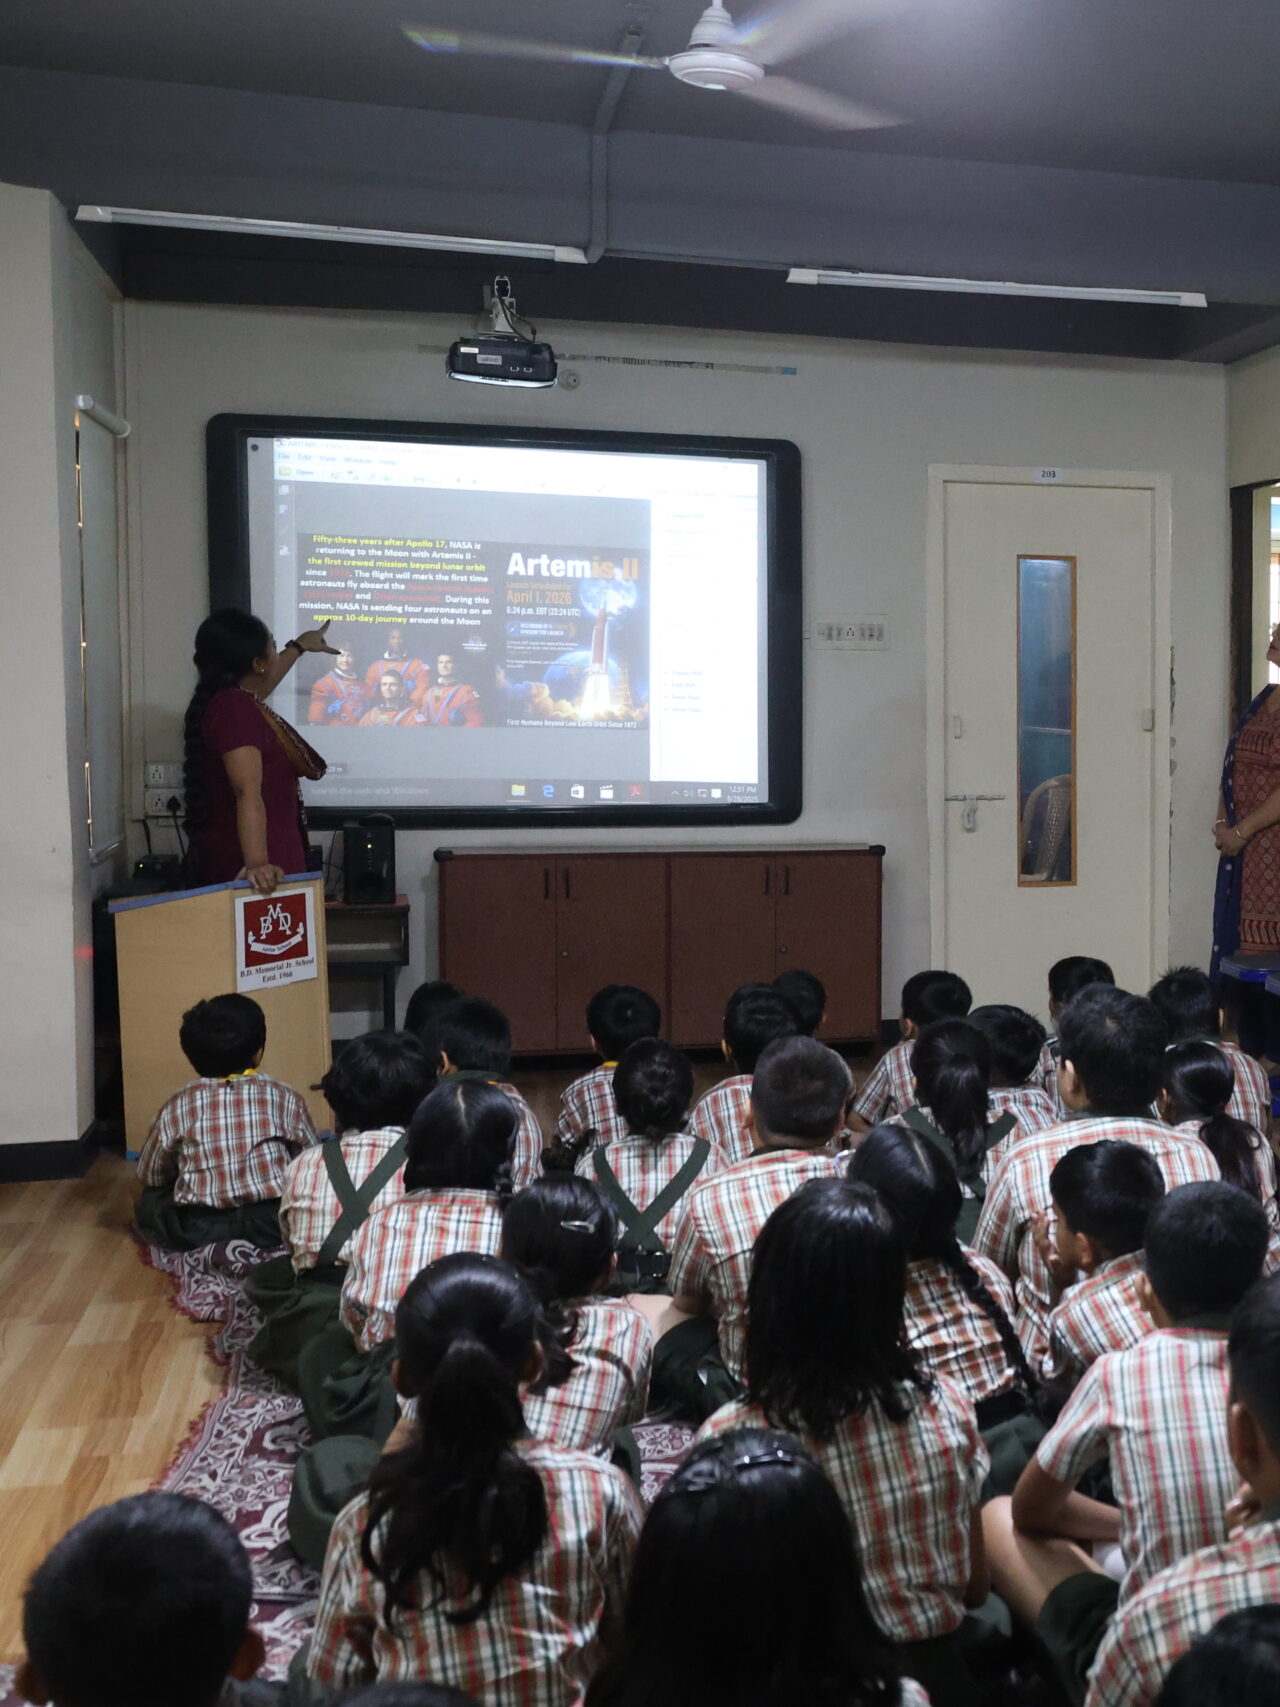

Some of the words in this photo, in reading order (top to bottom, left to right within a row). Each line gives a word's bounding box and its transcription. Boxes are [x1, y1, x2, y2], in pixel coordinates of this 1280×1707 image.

[1041, 470, 1056, 478] 203
[313, 535, 357, 544] Fifty-three
[360, 538, 382, 546] years
[384, 538, 404, 546] after
[406, 539, 433, 548] Apollo
[449, 541, 472, 549] NASA
[316, 547, 355, 557] returning
[368, 547, 382, 556] the
[384, 549, 409, 557] Moon
[411, 550, 429, 558] with
[432, 551, 464, 559] Artemis
[307, 557, 322, 565] the
[324, 557, 341, 565] first
[343, 559, 374, 567] crewed
[376, 560, 408, 568] mission
[410, 561, 440, 570] beyond
[442, 562, 464, 570] lunar
[507, 552, 614, 579] Artemis
[306, 568, 327, 576] since
[354, 570, 370, 578] The
[372, 570, 394, 580] flight
[395, 571, 411, 579] will
[412, 572, 433, 580] mark
[435, 573, 449, 581] the
[451, 573, 467, 581] first
[469, 574, 488, 582] time
[300, 580, 345, 588] astronauts
[347, 580, 358, 590] fly
[360, 581, 389, 589] aboard
[391, 582, 405, 590] the
[355, 592, 371, 600] and
[445, 595, 472, 605] During
[474, 596, 490, 604] this
[507, 589, 533, 605] April
[545, 591, 573, 605] 2026
[299, 602, 334, 610] mission,
[336, 602, 360, 610] NASA
[370, 604, 403, 614] sending
[404, 604, 422, 613] four
[424, 606, 467, 614] astronauts
[313, 614, 343, 622] approx
[345, 614, 373, 623] 10-day
[375, 615, 407, 624] journey
[409, 616, 438, 624] around
[440, 617, 454, 625] the
[457, 617, 480, 625] Moon
[507, 718, 520, 726] First
[544, 719, 564, 727] Beyond
[607, 720, 622, 728] Since
[255, 963, 284, 975] Memorial
[295, 957, 314, 967] School
